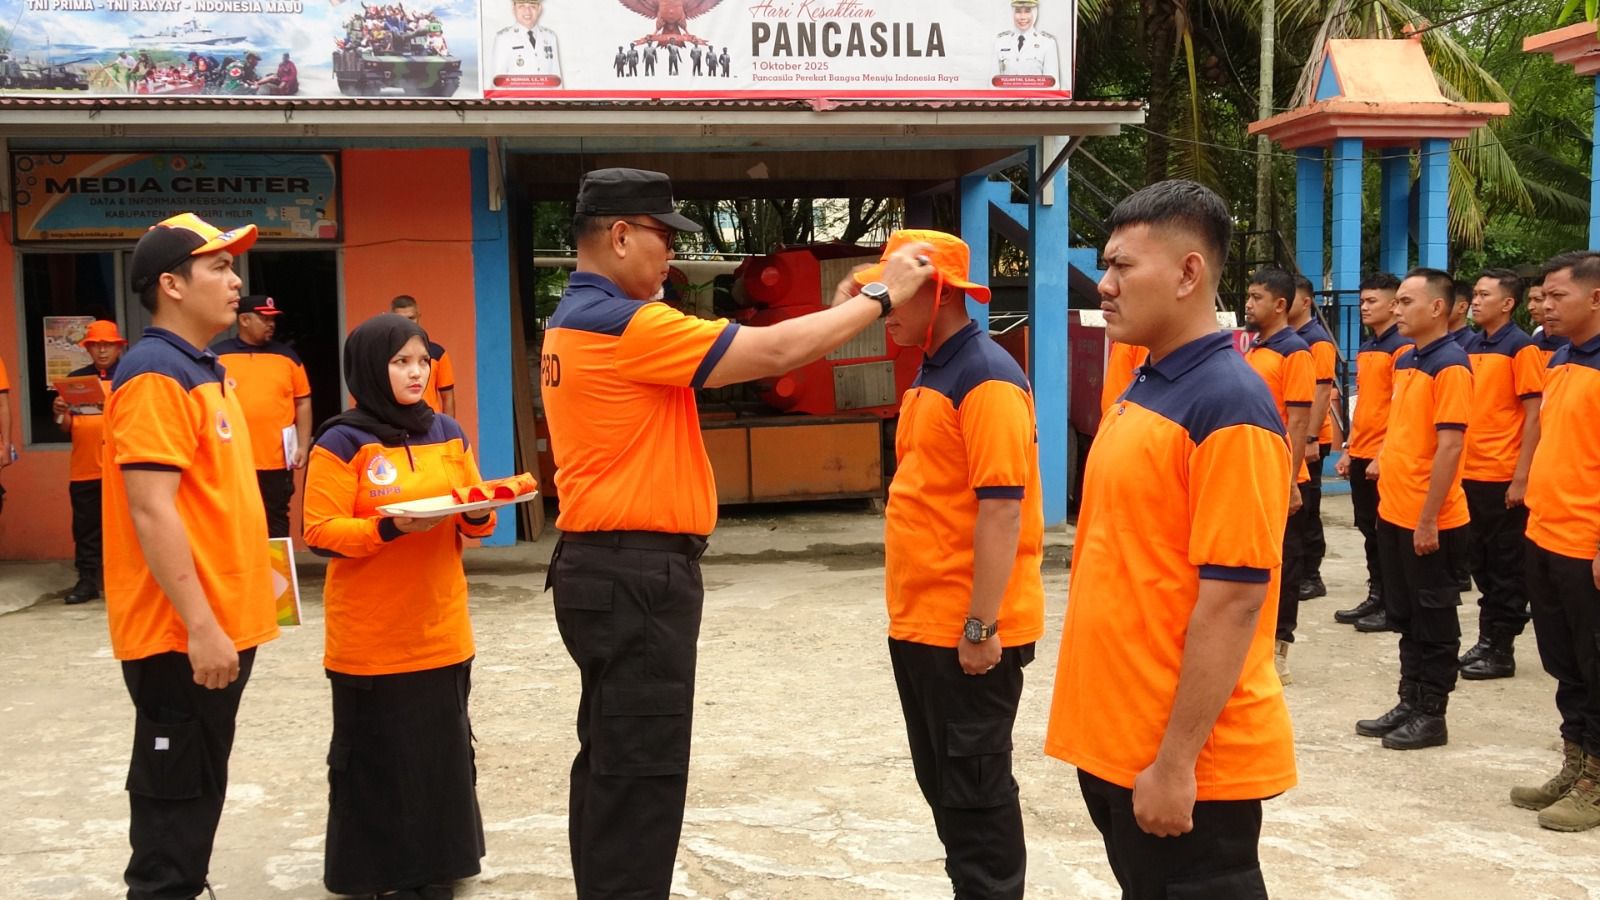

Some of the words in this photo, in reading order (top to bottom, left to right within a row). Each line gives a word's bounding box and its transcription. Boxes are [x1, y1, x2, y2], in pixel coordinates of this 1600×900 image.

[29, 0, 49, 11] TNI
[53, 0, 95, 11] PRIMA
[108, 0, 128, 11] TNI
[131, 0, 182, 12] RAKYAT
[194, 1, 263, 13] INDONESIA
[266, 1, 304, 13] MAJU
[749, 0, 793, 18] Hari
[796, 0, 877, 21] Kesaktian
[751, 21, 946, 58] PANCASILA
[752, 61, 757, 71] 1
[760, 61, 802, 71] Oktober
[804, 61, 829, 71] 2025
[752, 73, 794, 82] Pancasila
[795, 73, 827, 82] Perekat
[829, 73, 861, 83] Bangsa
[862, 73, 893, 83] Menuju
[895, 73, 936, 82] Indonesia
[938, 73, 959, 83] Raya
[45, 177, 164, 193] MEDIA
[171, 176, 310, 193] CENTER
[90, 197, 117, 206] DATA
[119, 197, 126, 206] &
[128, 197, 187, 206] INFORMASI
[189, 196, 267, 205] KEBENCANAAN
[105, 209, 166, 217] KABUPATEN
[226, 209, 253, 217] HILIR
[369, 486, 401, 498] BNPB
